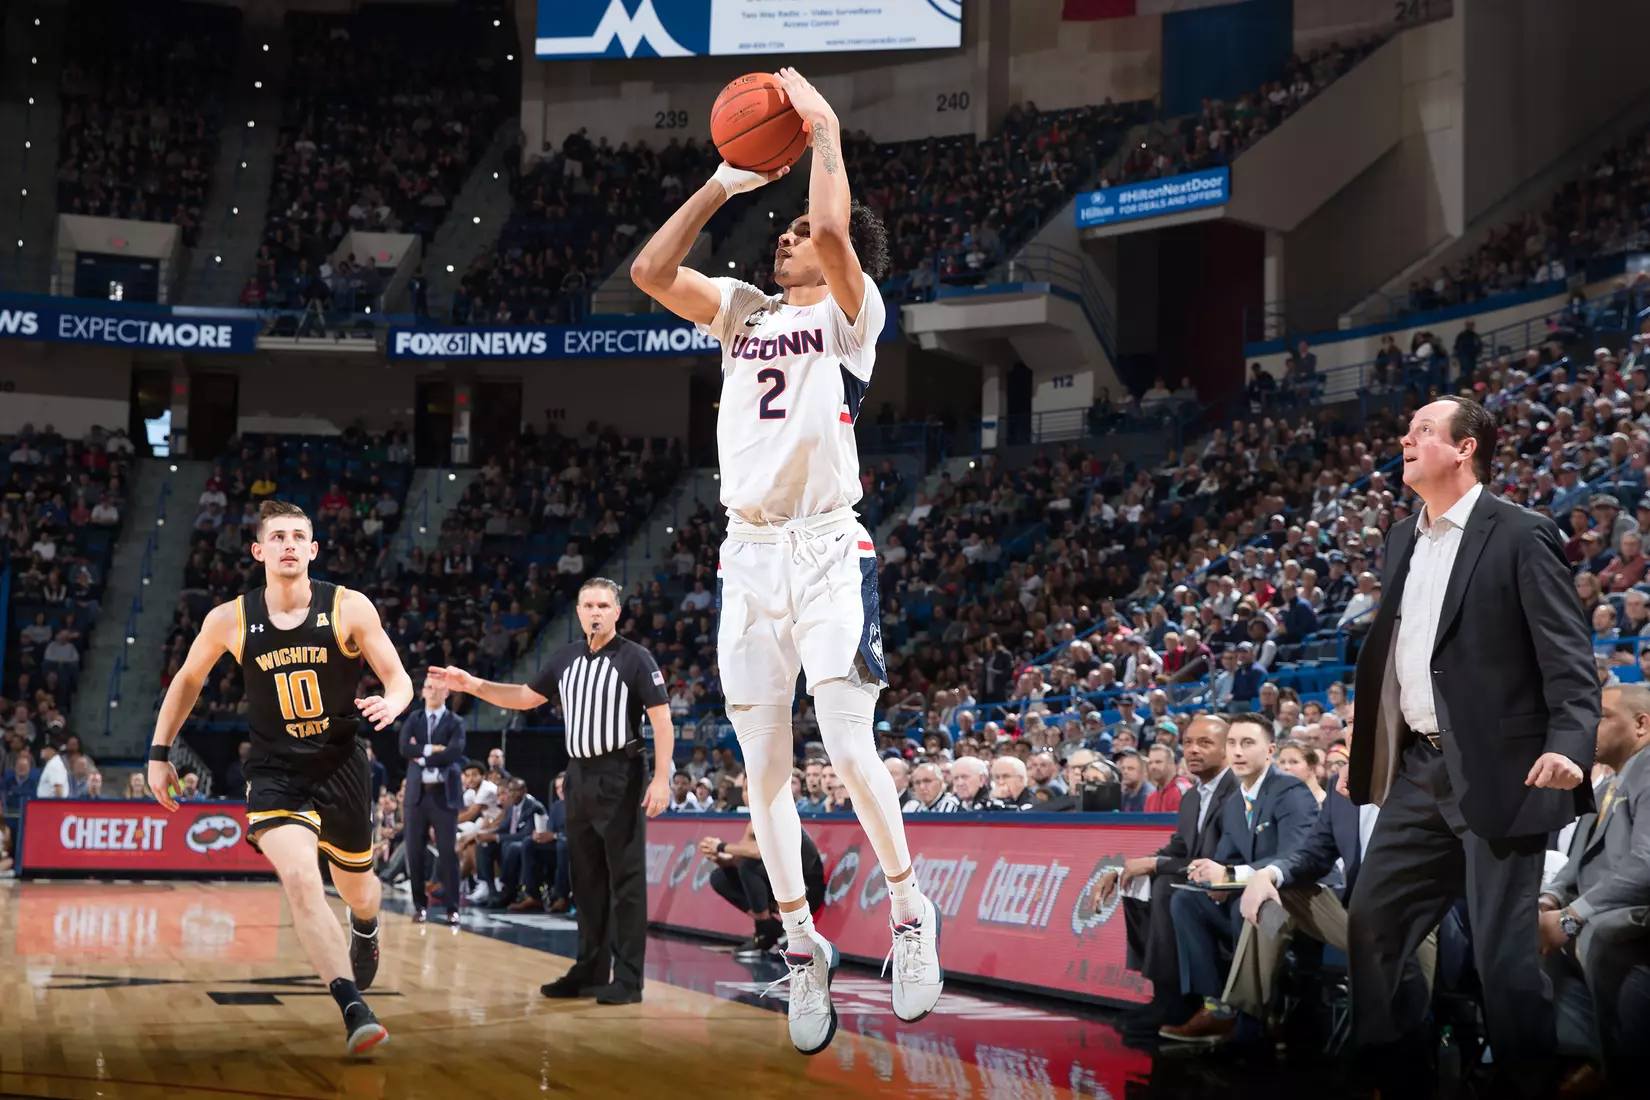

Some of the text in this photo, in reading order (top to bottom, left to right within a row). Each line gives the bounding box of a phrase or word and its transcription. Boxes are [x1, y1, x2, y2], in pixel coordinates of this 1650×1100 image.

[778, 9, 800, 18] Radio
[811, 8, 833, 16] Video
[783, 19, 839, 29] Access Control
[936, 91, 970, 112] 240
[654, 110, 689, 129] 239
[1119, 176, 1224, 205] #HiltonNextDoor
[1119, 190, 1223, 215] FOR DEALS AND OFFERS
[731, 328, 824, 361] UCONN
[757, 367, 786, 420] 2
[1052, 374, 1075, 389] 112
[255, 646, 328, 672] WICHITA
[274, 669, 324, 720] 10
[285, 716, 330, 739] STATE
